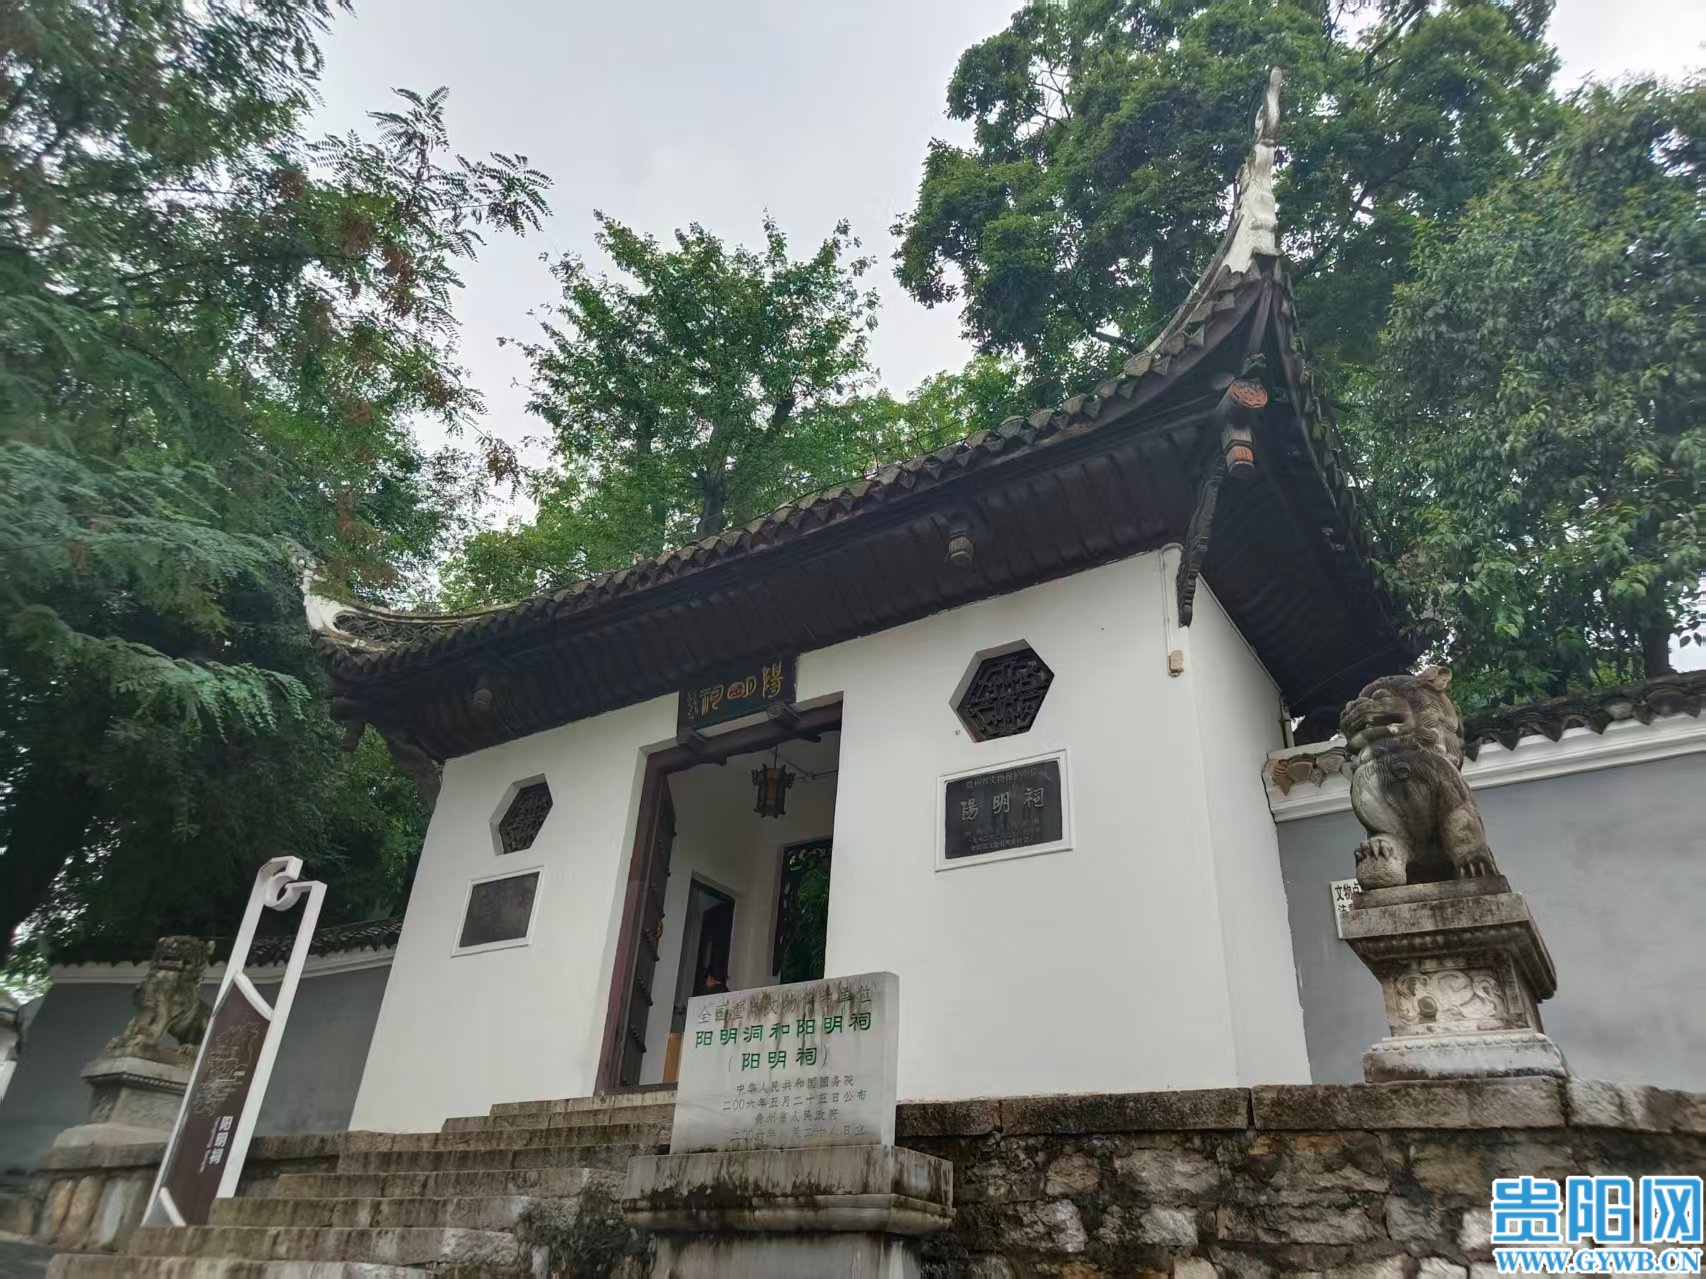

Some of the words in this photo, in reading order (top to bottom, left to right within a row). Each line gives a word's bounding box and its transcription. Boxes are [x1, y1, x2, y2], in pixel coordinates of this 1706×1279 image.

[960, 787, 1045, 820] 陽明祠
[695, 1012, 872, 1048] 阳明洞和阳明祠
[736, 1075, 855, 1095] 中华人民共和国国务院
[754, 1109, 839, 1125] 贵州省人民政府
